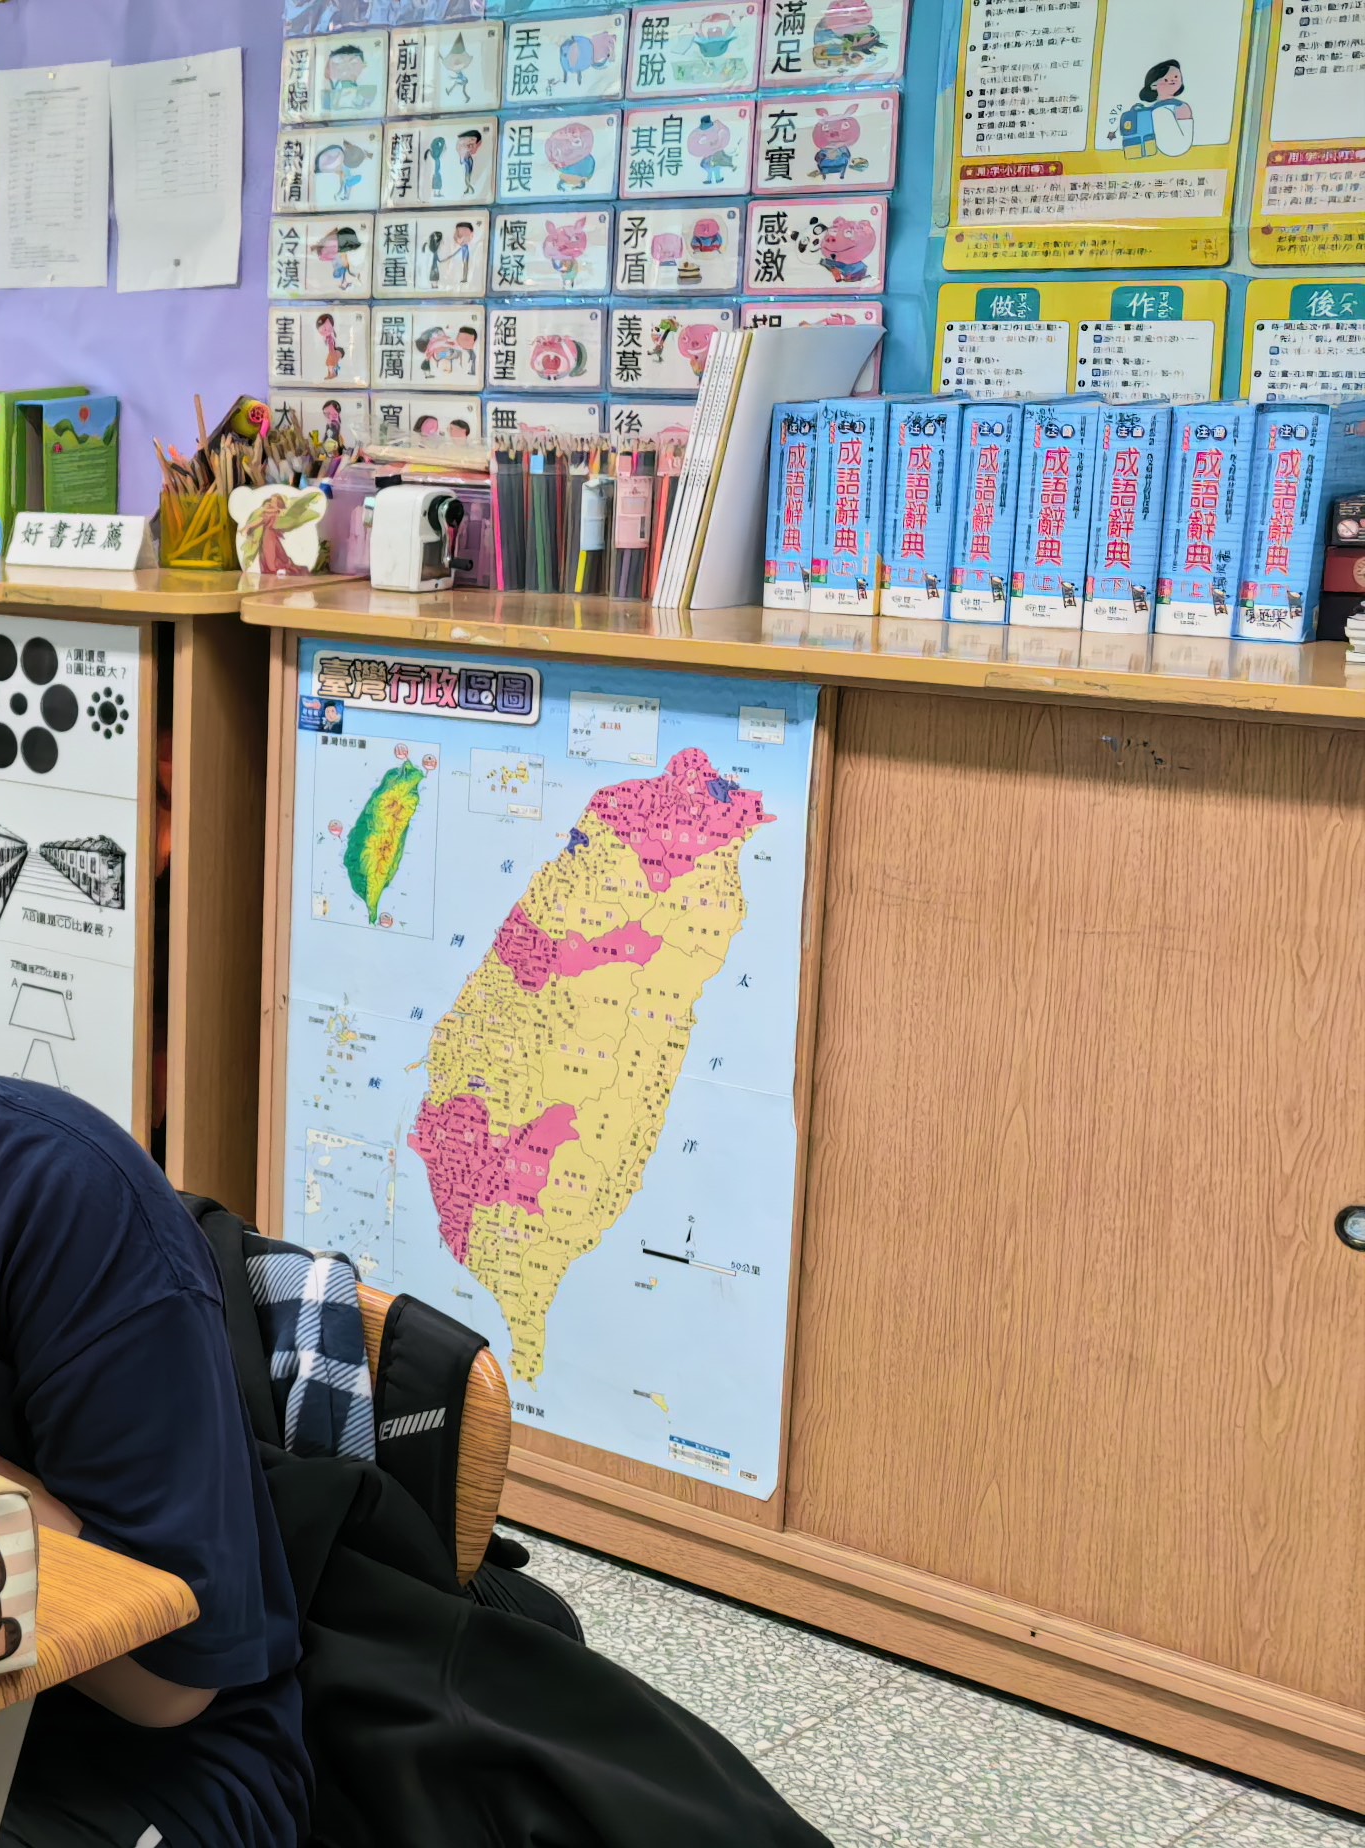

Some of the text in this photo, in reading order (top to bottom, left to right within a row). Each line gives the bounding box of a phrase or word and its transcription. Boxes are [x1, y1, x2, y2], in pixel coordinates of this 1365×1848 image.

[512, 27, 541, 97] 丟臉
[636, 16, 670, 88] 解脫
[770, 0, 809, 75] 滿足
[395, 40, 419, 105] 前衛
[506, 125, 535, 193] 沮喪
[764, 109, 798, 182] 充實
[276, 226, 301, 289] 冷漠
[381, 223, 410, 288] 穩重
[497, 218, 527, 286] 懷疑
[620, 216, 648, 286] 矛盾
[753, 211, 789, 283] 感激
[989, 295, 1017, 319] 做
[1127, 293, 1156, 319] 作
[1306, 290, 1338, 318] 後
[275, 315, 296, 377] 害羞
[379, 316, 405, 380] 嚴厲
[493, 314, 517, 380] 絕望
[615, 314, 644, 383] 羨慕
[782, 443, 808, 554] 成語辭典
[834, 438, 863, 556] 成語辭典
[901, 444, 933, 561] 成語辭典
[970, 444, 1000, 561] 成語辭典
[1035, 447, 1070, 566] 成語辭典
[1105, 448, 1141, 571] 成語辭典
[1184, 448, 1224, 573] 成語辭典
[1265, 449, 1302, 576] 成語辭典
[21, 520, 124, 551] 好書推薦
[317, 657, 534, 716] 臺灣行政區圖
[320, 735, 367, 749] 臺灣地形圖
[22, 907, 113, 938] AB還是CD比較長？
[11, 978, 18, 988] A
